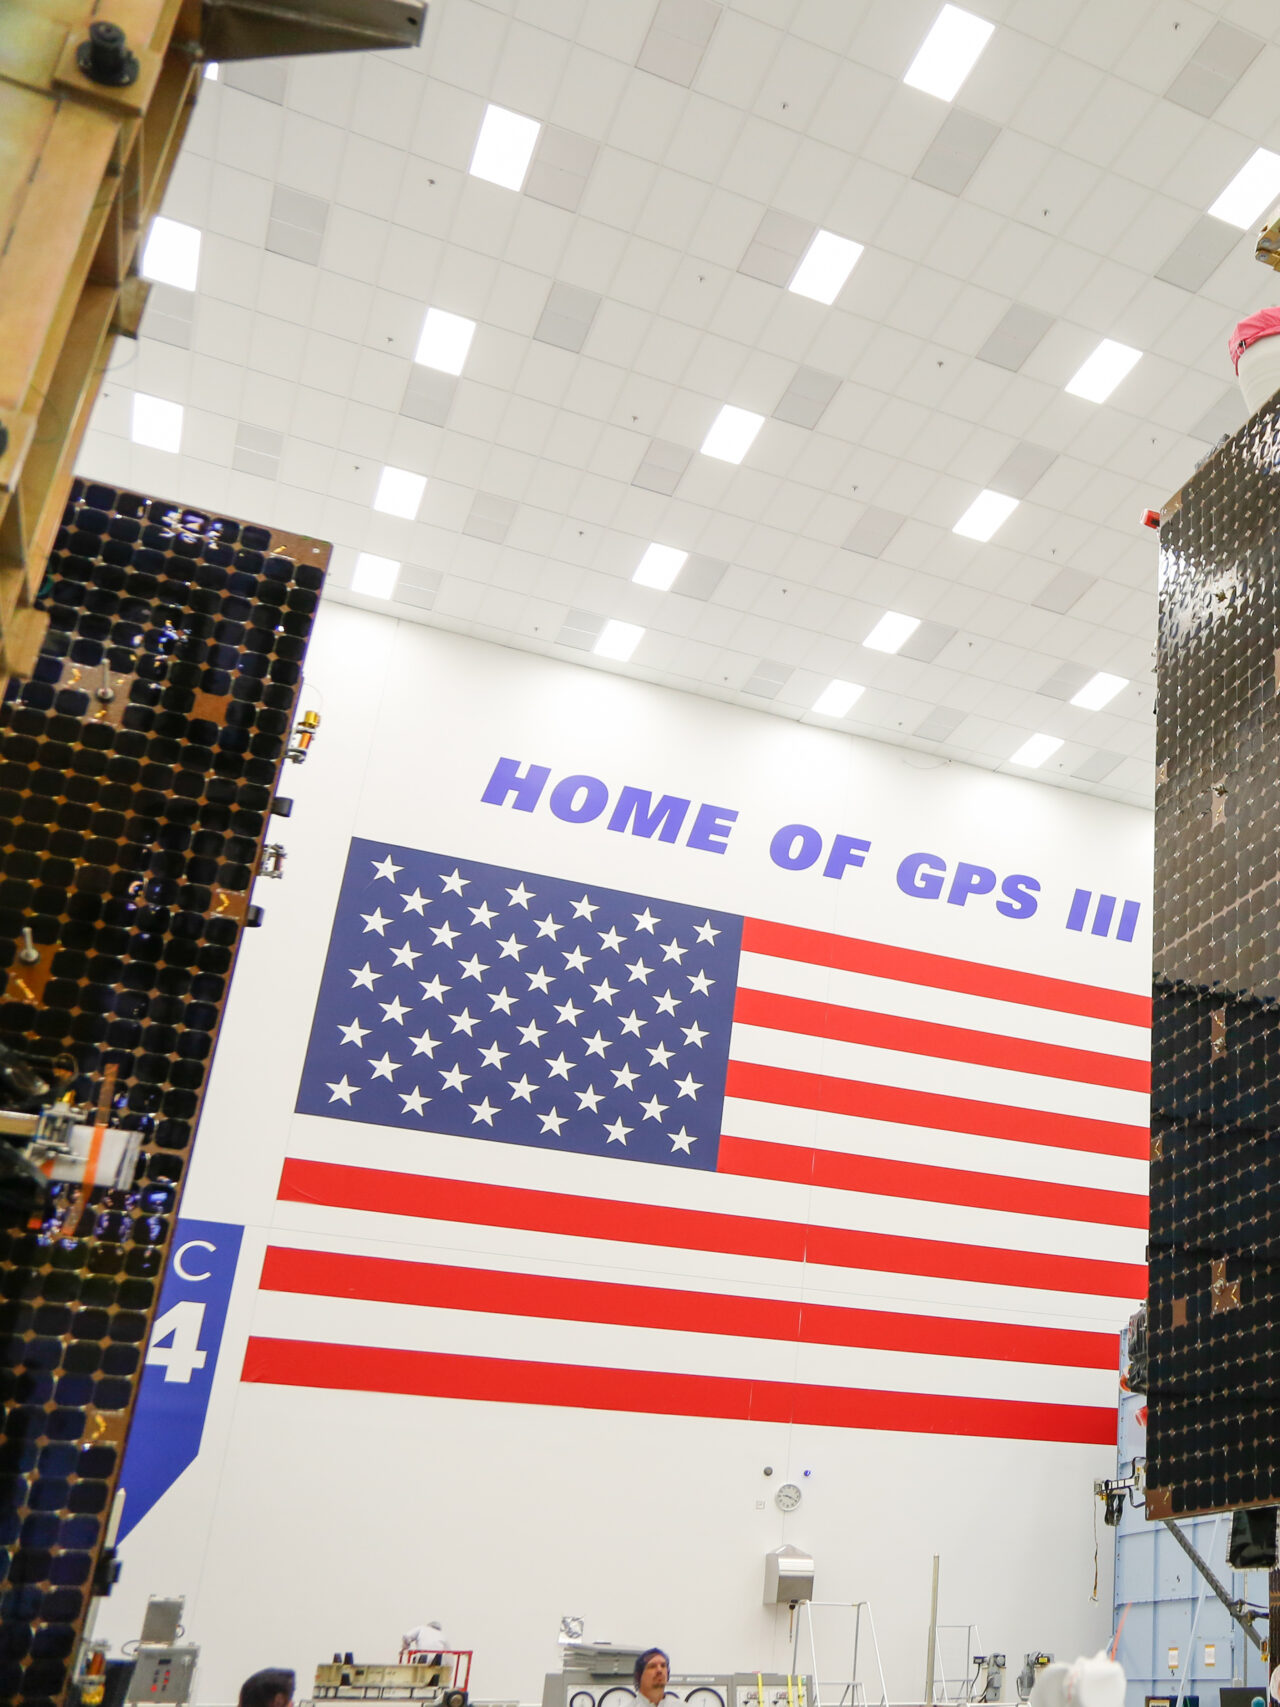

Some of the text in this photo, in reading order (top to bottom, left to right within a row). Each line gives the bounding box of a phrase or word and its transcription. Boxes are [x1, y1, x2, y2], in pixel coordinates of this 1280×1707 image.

[481, 757, 1141, 943] HOME OF GPS III
[172, 1240, 217, 1282] C
[144, 1300, 208, 1384] 4
